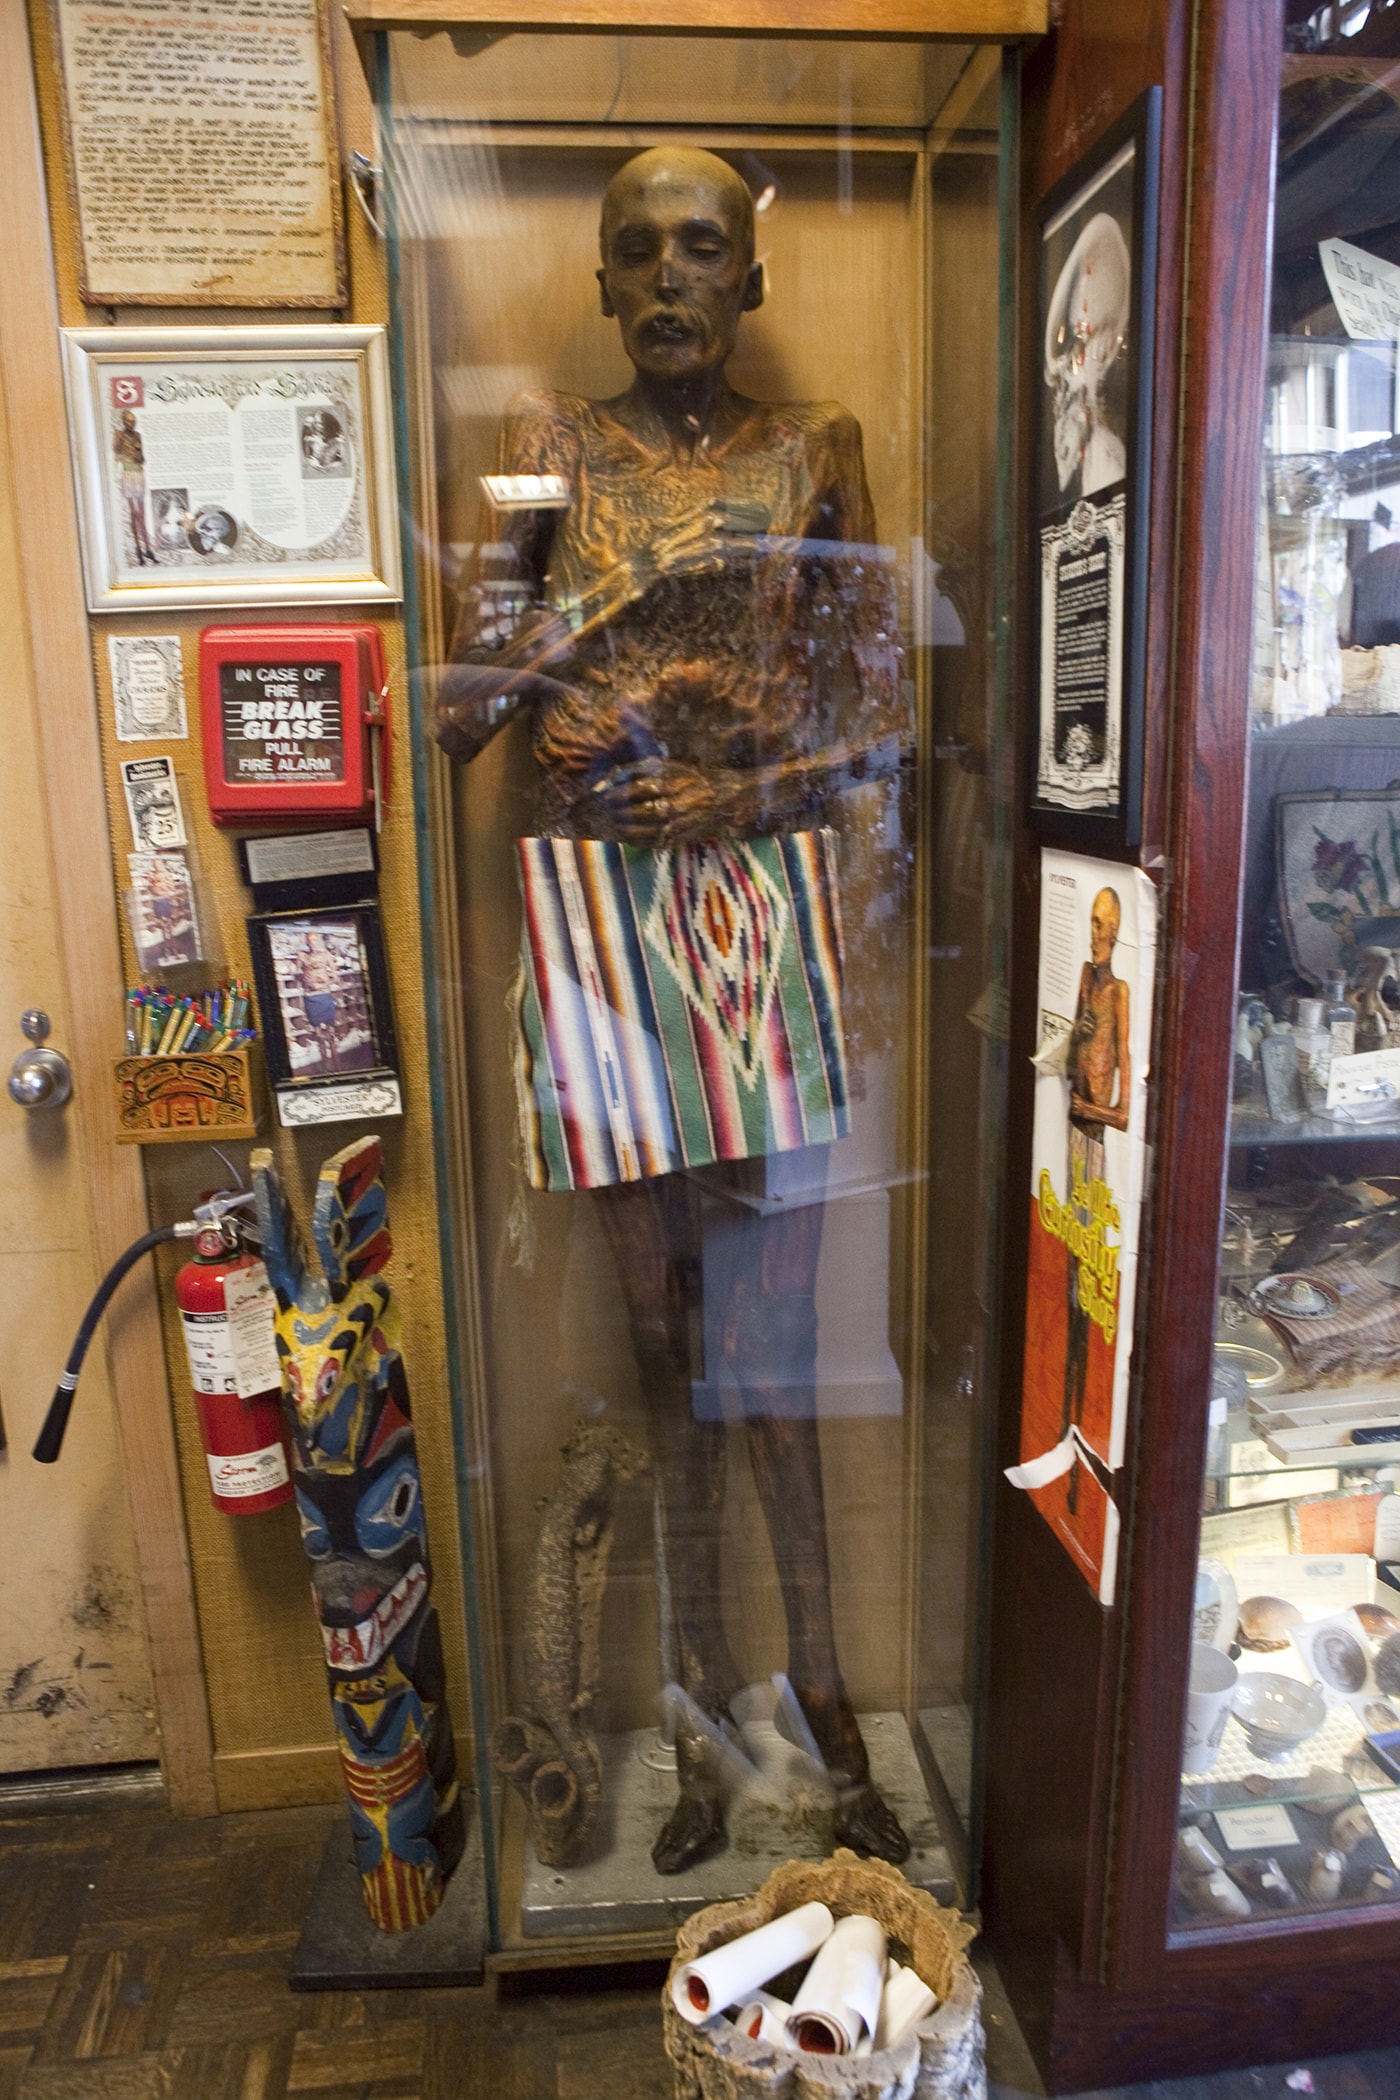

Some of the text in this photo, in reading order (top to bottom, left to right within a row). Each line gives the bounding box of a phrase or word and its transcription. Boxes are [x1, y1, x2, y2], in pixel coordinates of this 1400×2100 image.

[1331, 249, 1357, 281] This
[235, 667, 327, 682] IN CASE OF
[263, 684, 299, 698] FIRE
[240, 701, 324, 720] BREAK
[242, 720, 324, 740] GLASS
[264, 742, 304, 756] PULL
[239, 757, 332, 772] FIRE ALARM
